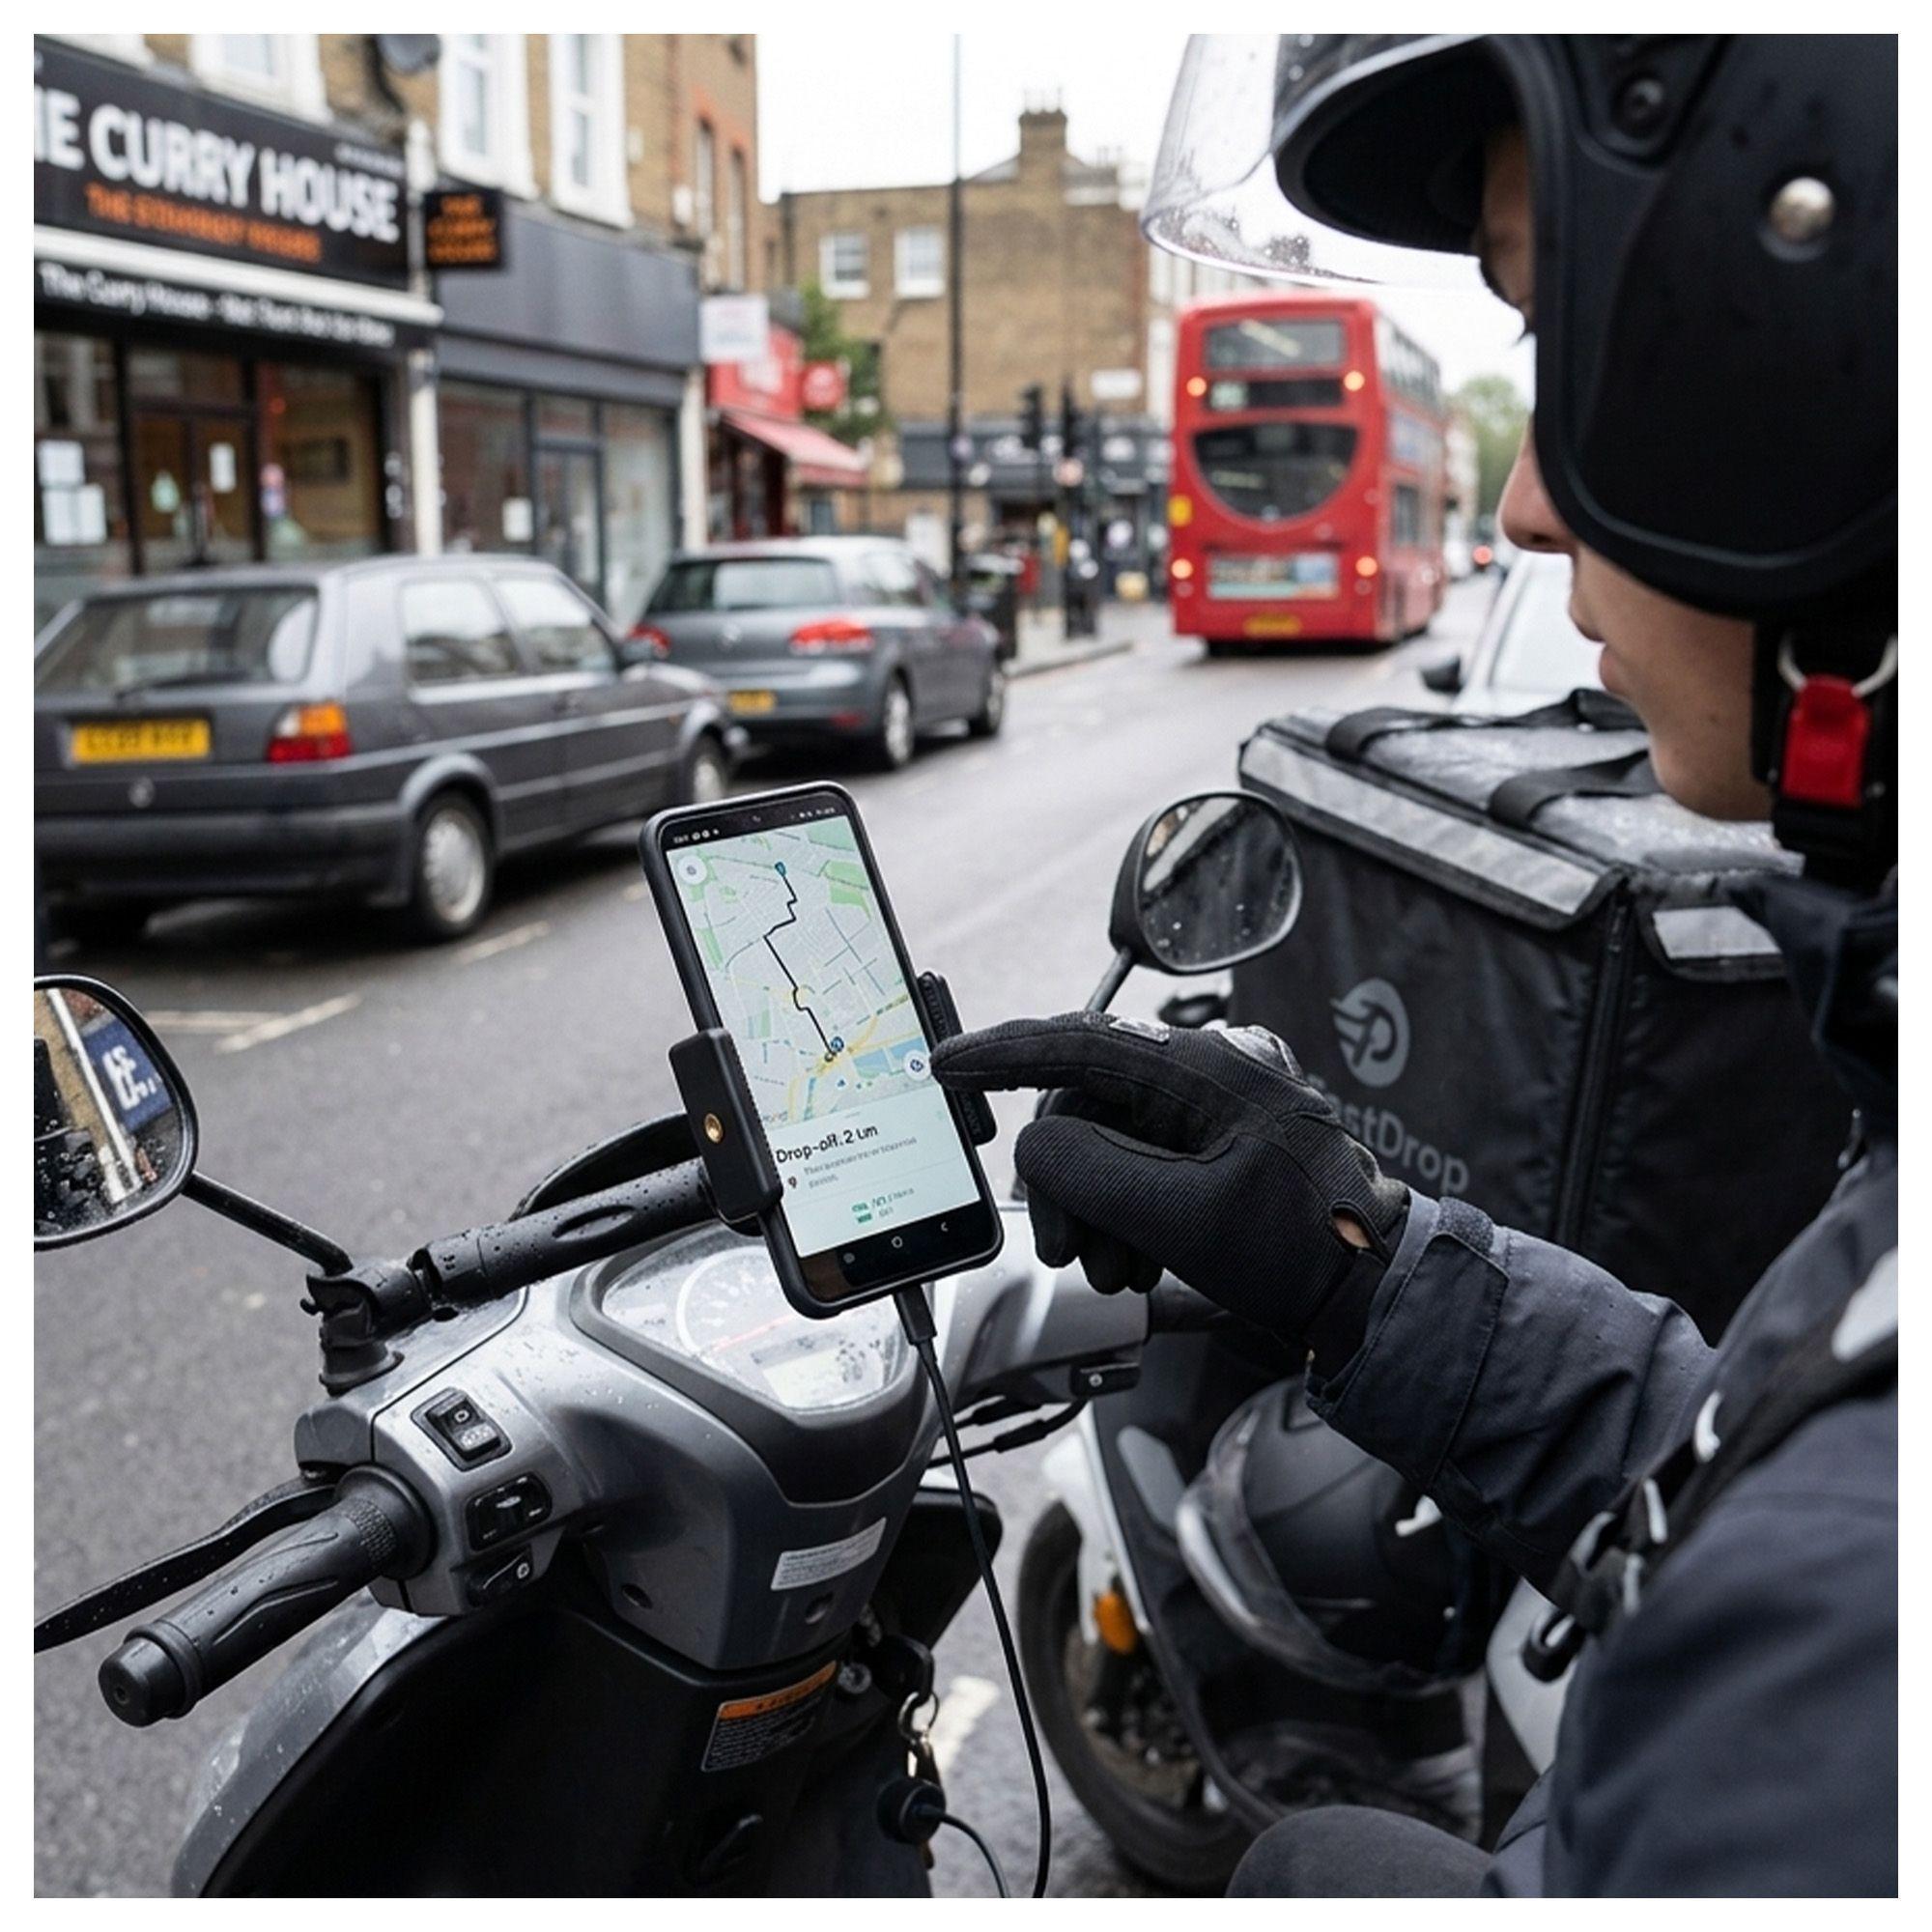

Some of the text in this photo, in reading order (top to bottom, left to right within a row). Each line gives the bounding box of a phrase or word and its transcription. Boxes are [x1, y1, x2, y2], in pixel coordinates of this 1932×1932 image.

[35, 87, 84, 169] E
[89, 104, 254, 208] CURRY
[259, 147, 399, 242] HOUSE
[39, 261, 85, 300] The
[843, 1129, 854, 1144] 2
[1307, 1073, 1469, 1195] stDrop
